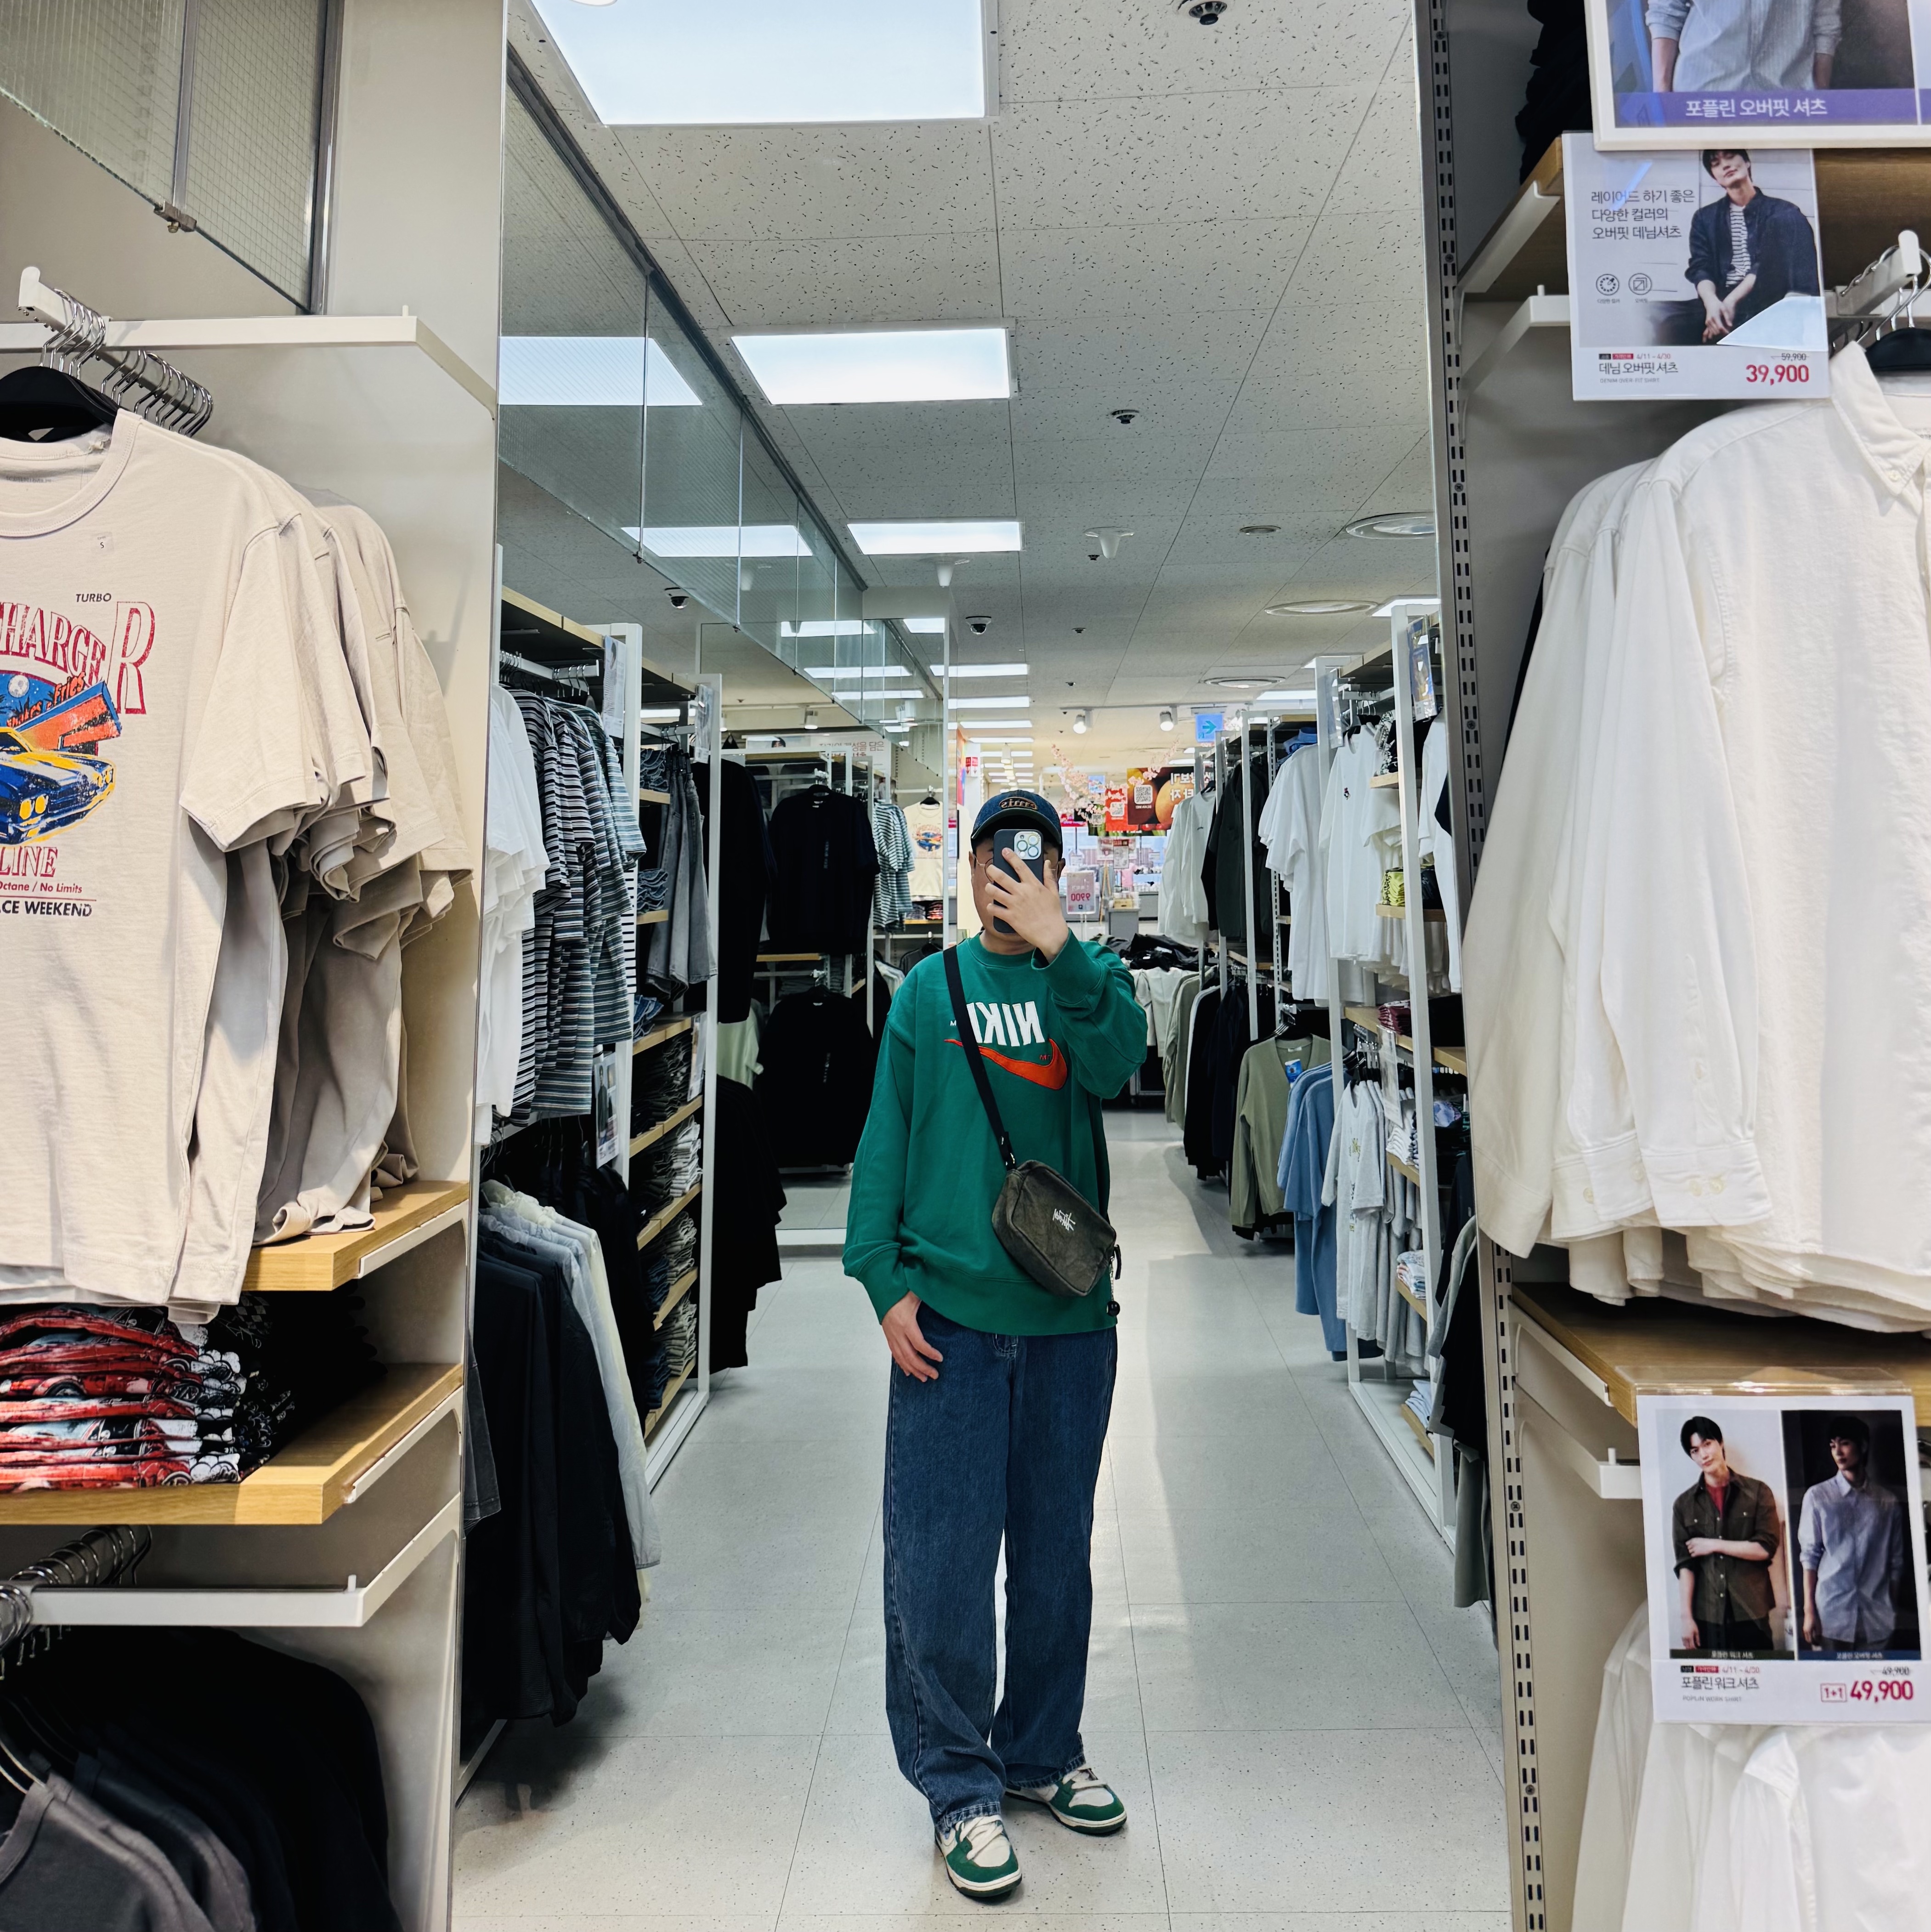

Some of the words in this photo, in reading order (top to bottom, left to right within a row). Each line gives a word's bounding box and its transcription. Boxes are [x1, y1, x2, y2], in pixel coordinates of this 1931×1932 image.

[1686, 99, 1736, 118] 포플린
[1739, 98, 1789, 118] 오버핏
[1794, 97, 1828, 117] 셔츠
[1591, 191, 1640, 204] 레이어드
[1643, 190, 1667, 203] 하기
[1670, 190, 1695, 203] 좋은
[1592, 209, 1629, 222] 다양한
[1631, 208, 1668, 221] 컬러의
[1592, 227, 1629, 240] 오버핏
[1632, 226, 1682, 239] 데님셔츠
[1599, 362, 1620, 374] 데님
[1622, 362, 1655, 374] 오버핏
[1656, 362, 1678, 374] 셔츠
[1746, 364, 1809, 385] 39,900
[76, 593, 112, 603] TURBO
[40, 883, 53, 892] No
[56, 883, 83, 894] Limits
[0, 900, 20, 914] CE
[24, 901, 92, 917] WEEKEND
[1681, 1676, 1713, 1690] 포플린
[1714, 1677, 1736, 1690] 워크
[1737, 1677, 1759, 1690] 셔츠
[1824, 1688, 1843, 1700] 1+1
[1851, 1680, 1914, 1703] 49,900
